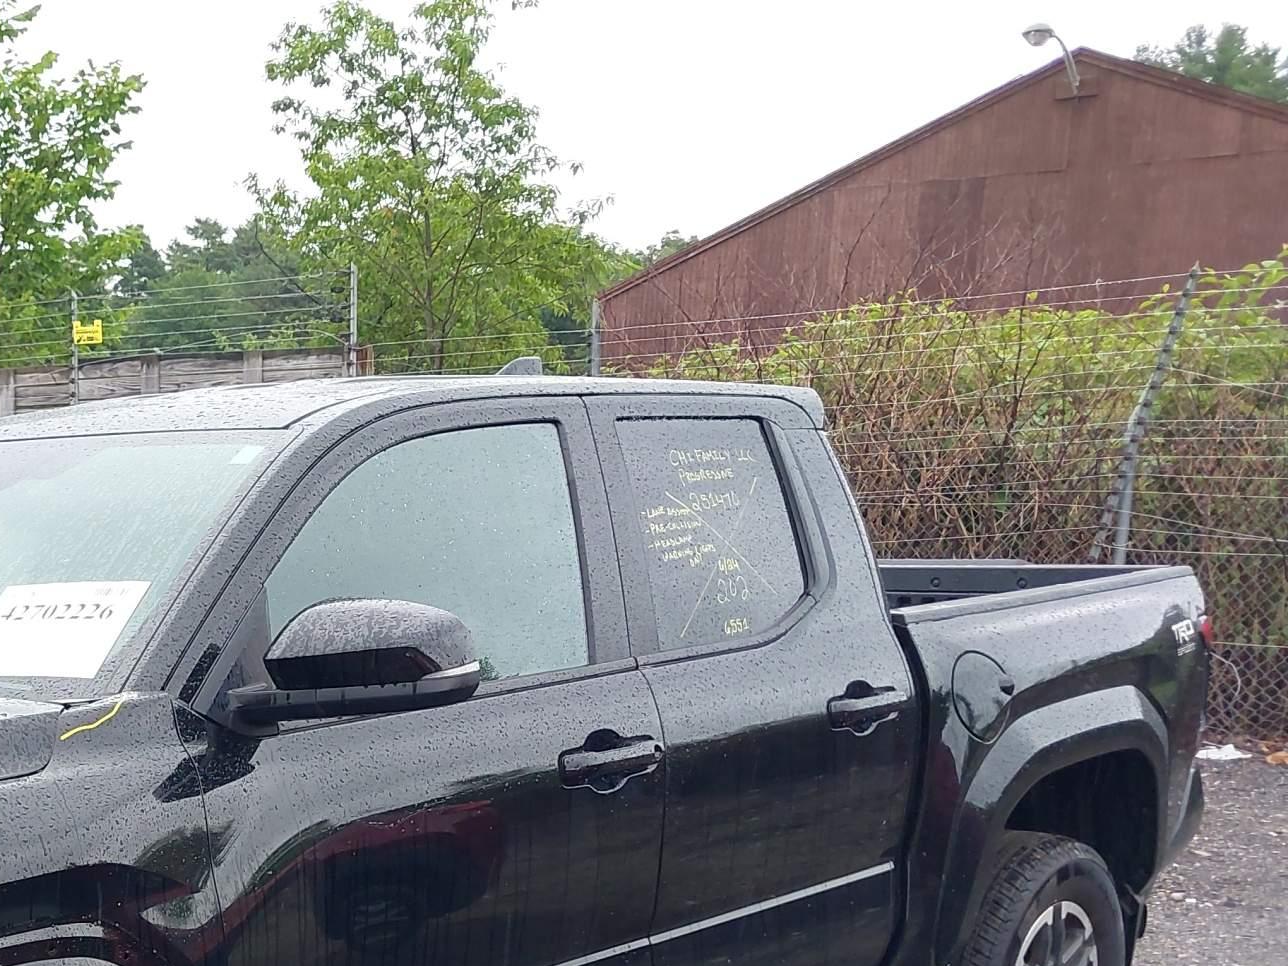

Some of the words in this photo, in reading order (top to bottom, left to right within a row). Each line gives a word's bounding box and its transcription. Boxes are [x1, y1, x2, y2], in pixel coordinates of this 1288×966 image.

[694, 448, 731, 464] FAMILY
[0, 603, 114, 621] 42702226
[1171, 619, 1195, 644] TRD
